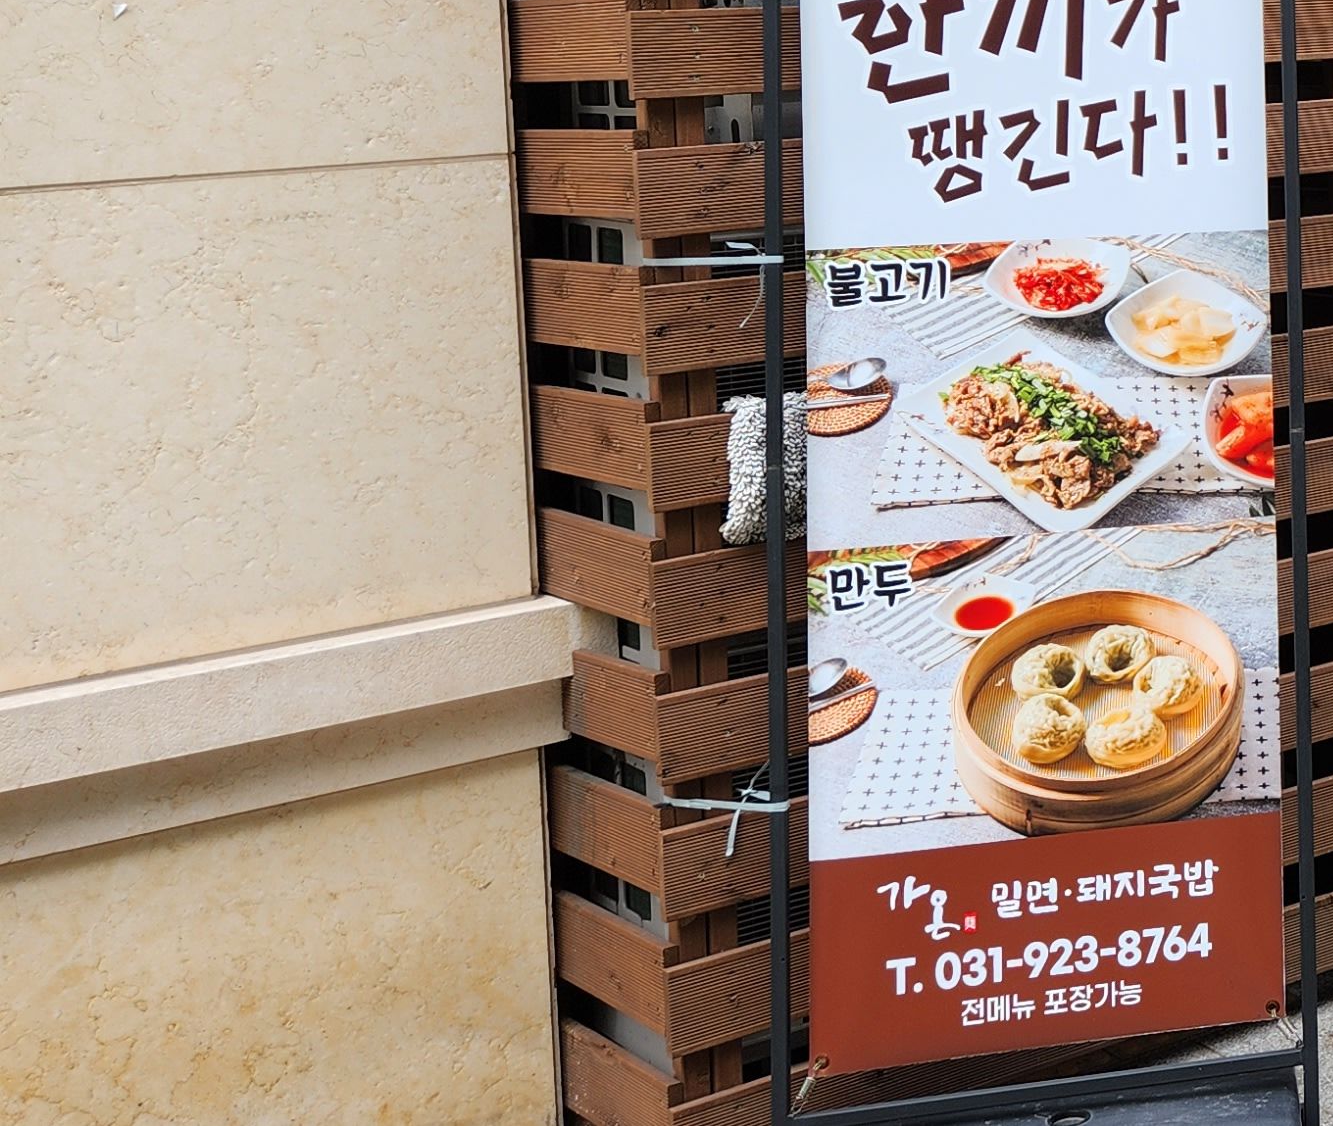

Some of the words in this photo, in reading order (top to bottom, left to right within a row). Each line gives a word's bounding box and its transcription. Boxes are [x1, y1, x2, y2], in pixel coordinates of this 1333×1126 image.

[908, 84, 1230, 203] 땡긴다!!
[825, 258, 952, 310] 불고기
[828, 562, 914, 612] 만두
[886, 957, 924, 996] T.
[934, 923, 1212, 990] 031-923-8764
[960, 996, 1036, 1027] 전메뉴
[1043, 979, 1143, 1017] 포장가능
